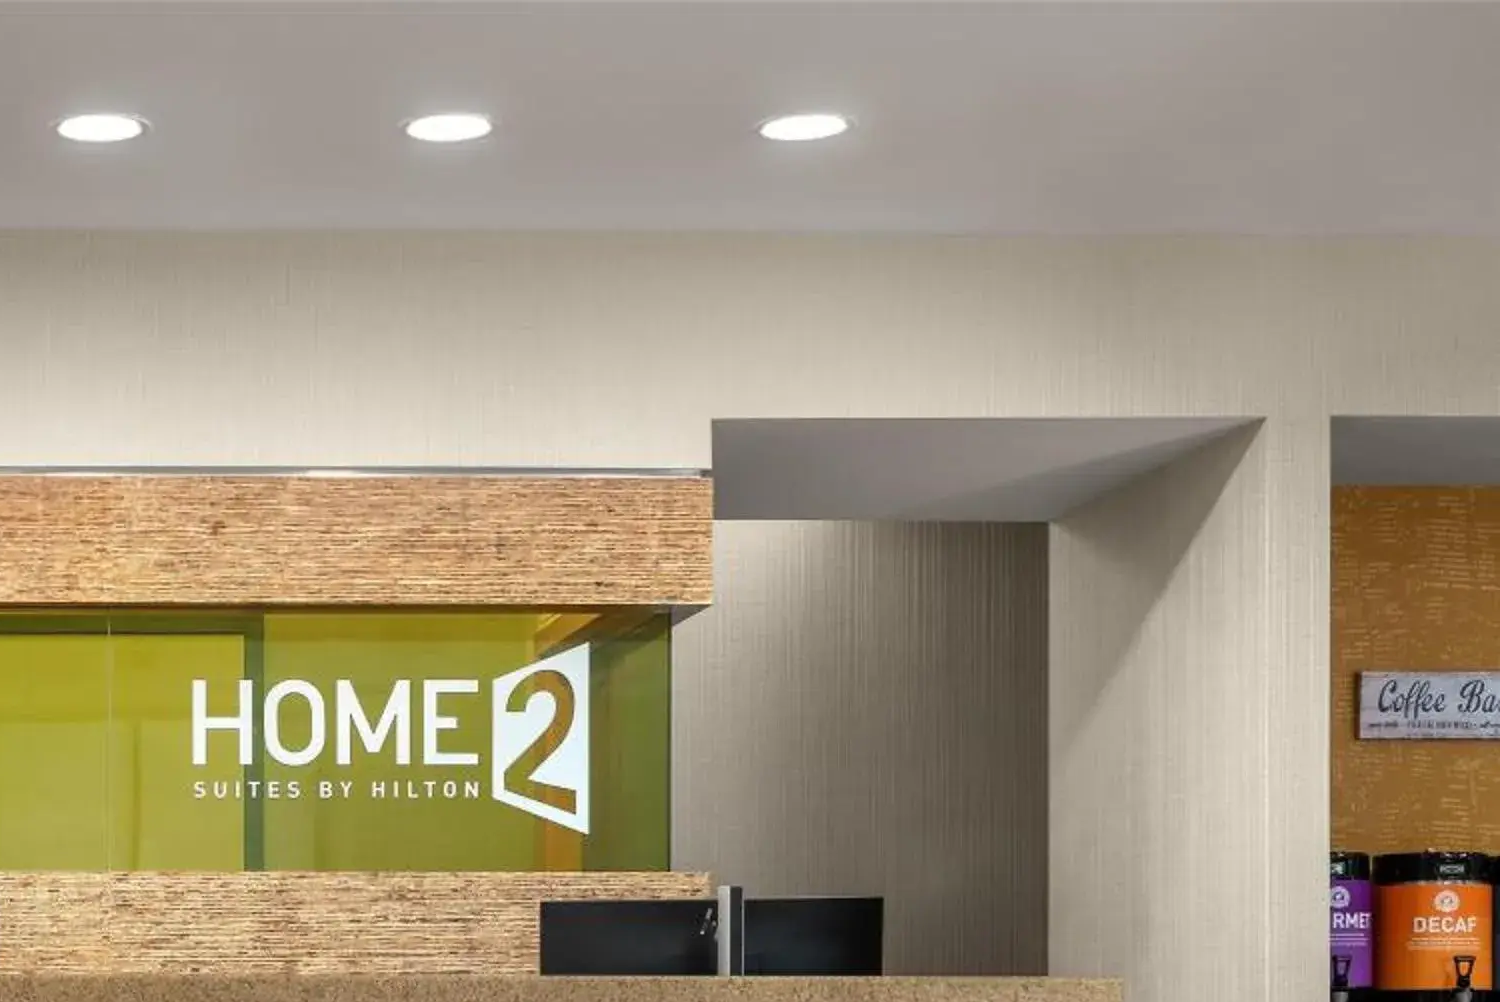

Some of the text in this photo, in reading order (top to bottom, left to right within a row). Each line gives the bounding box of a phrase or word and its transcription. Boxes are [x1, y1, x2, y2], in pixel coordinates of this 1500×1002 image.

[1378, 679, 1500, 719] Coffee Ba
[194, 781, 480, 798] SUITES BY HILTON
[1413, 916, 1477, 933] DECAF
